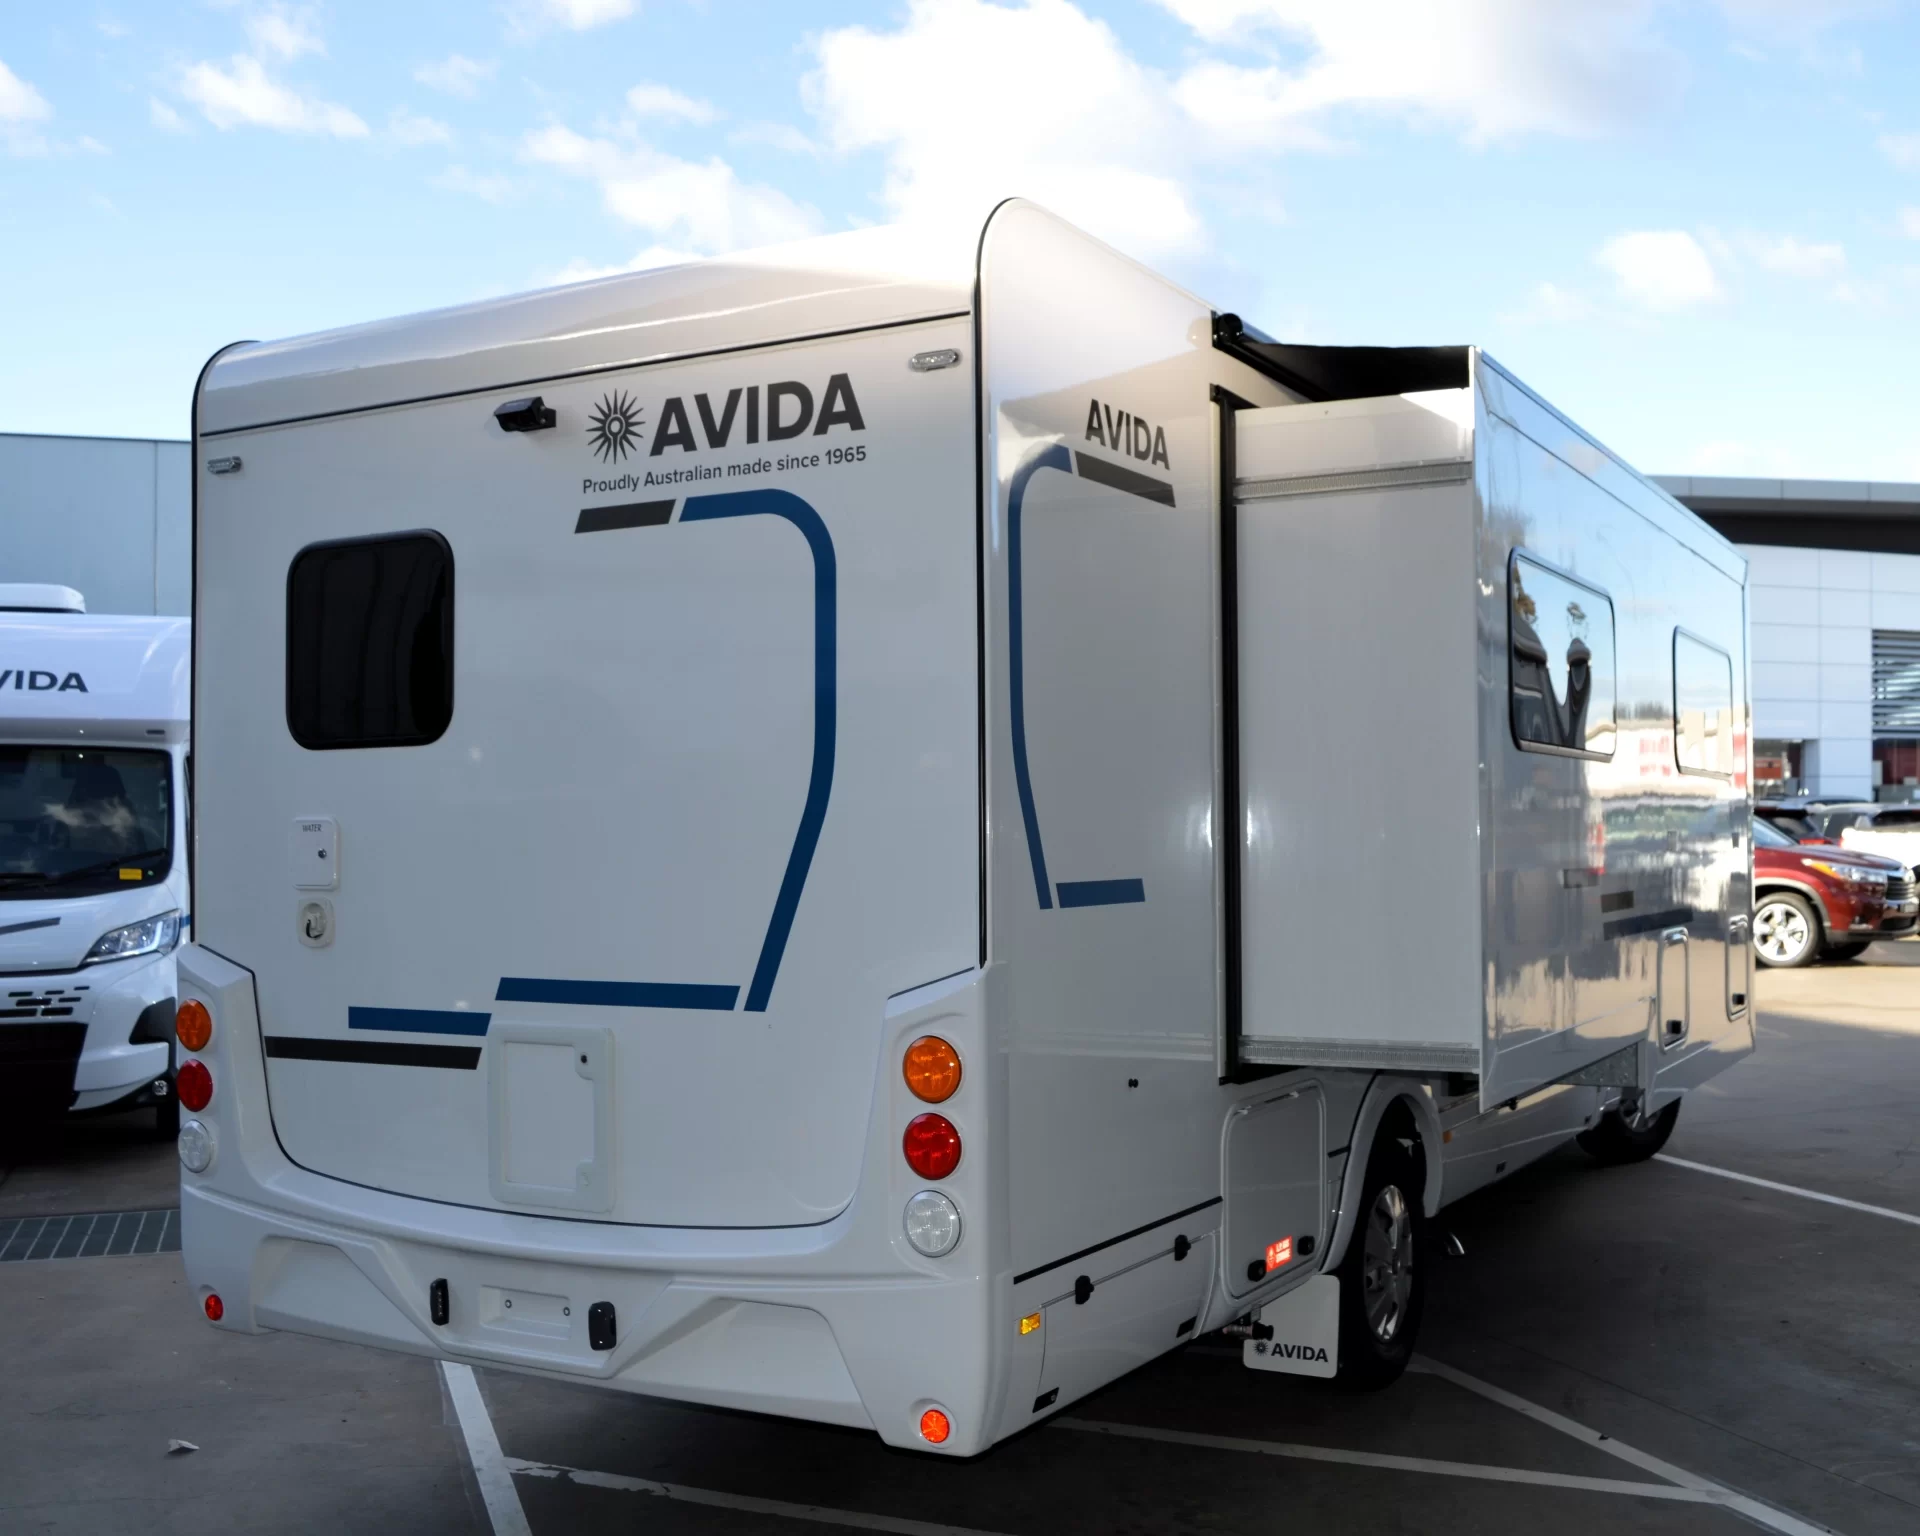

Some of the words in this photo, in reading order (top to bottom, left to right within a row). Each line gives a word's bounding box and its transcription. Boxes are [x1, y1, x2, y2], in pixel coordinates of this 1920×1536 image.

[649, 372, 866, 457] AVIDA
[1085, 398, 1170, 471] AVIDA
[583, 473, 640, 494] Proudly
[644, 464, 722, 487] Australian
[727, 455, 772, 477] made
[776, 451, 820, 472] since
[825, 445, 867, 465] 1965
[302, 823, 322, 833] WATER
[1271, 1342, 1329, 1363] AVIDA
